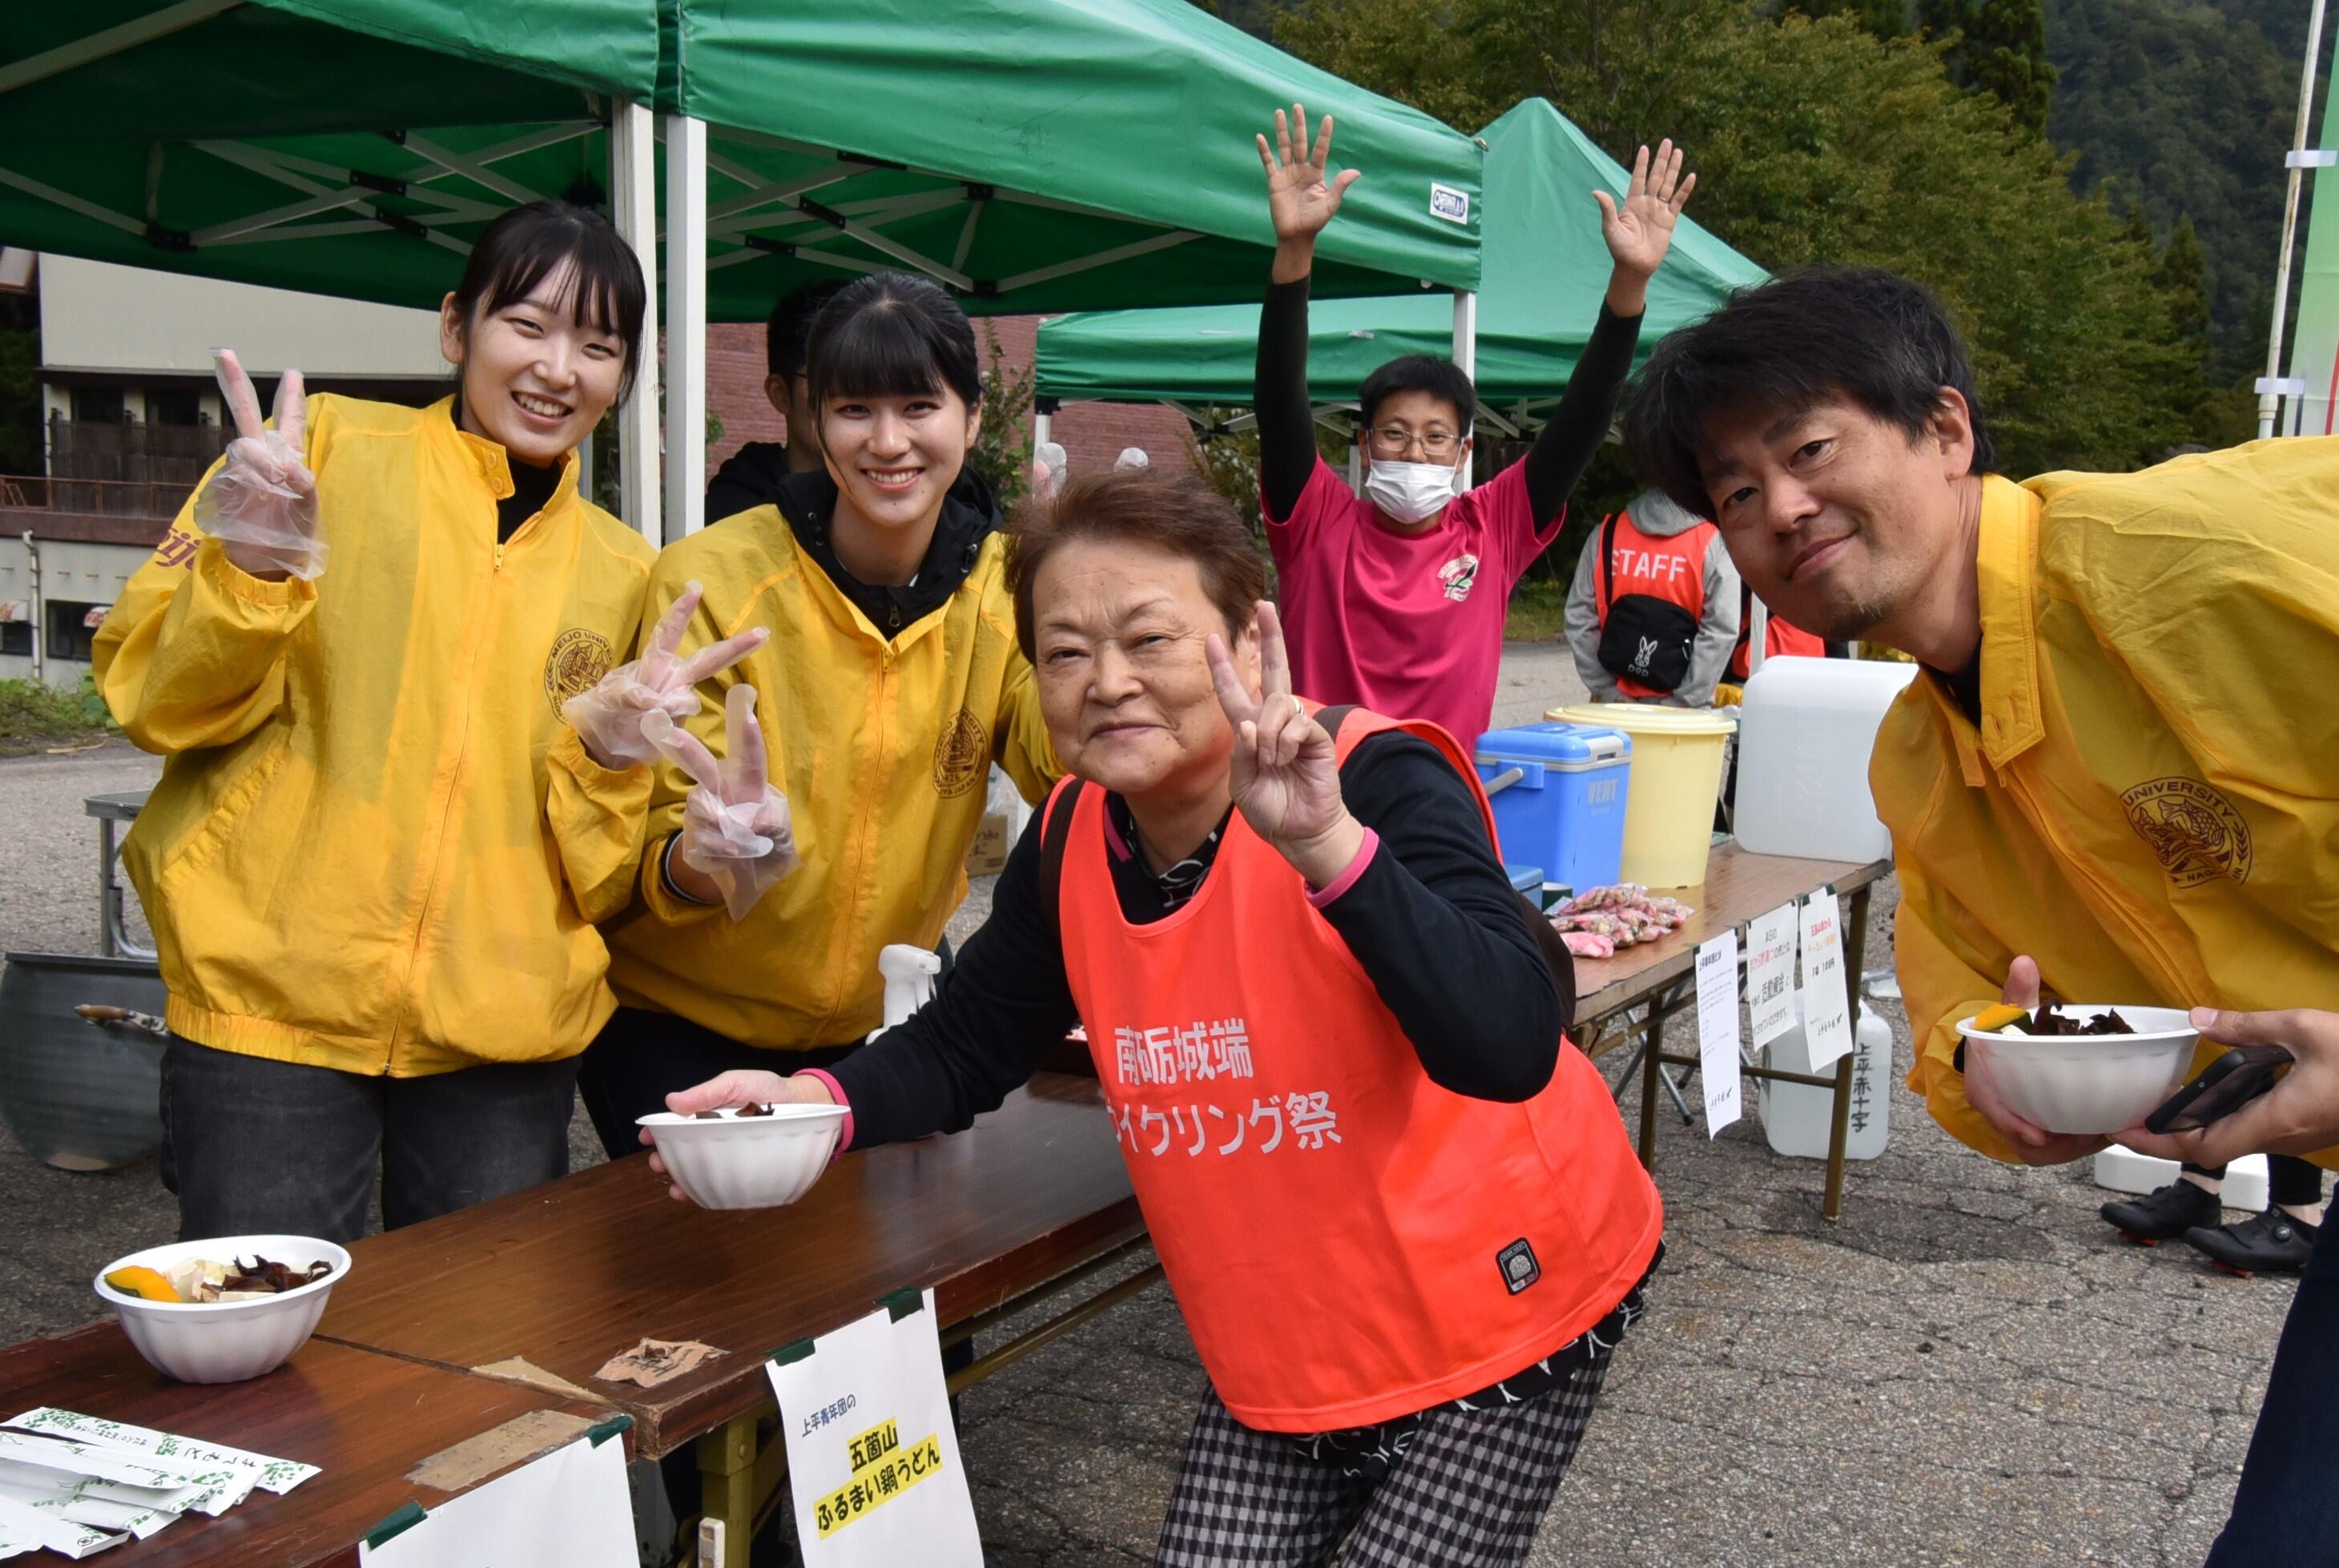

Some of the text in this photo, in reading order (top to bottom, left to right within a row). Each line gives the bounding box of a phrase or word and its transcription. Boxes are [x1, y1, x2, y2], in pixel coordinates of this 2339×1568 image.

[551, 631, 614, 661] MEIJO UNIVE
[2123, 781, 2234, 818] UNIVERSITY
[1115, 1017, 1254, 1086] 南砺城端
[1851, 1042, 1873, 1133] 上平赤十字
[802, 1393, 856, 1437] 上平青年団の
[849, 1424, 899, 1473] 五箇山
[818, 1442, 940, 1530] ふるまい鍋うどん
